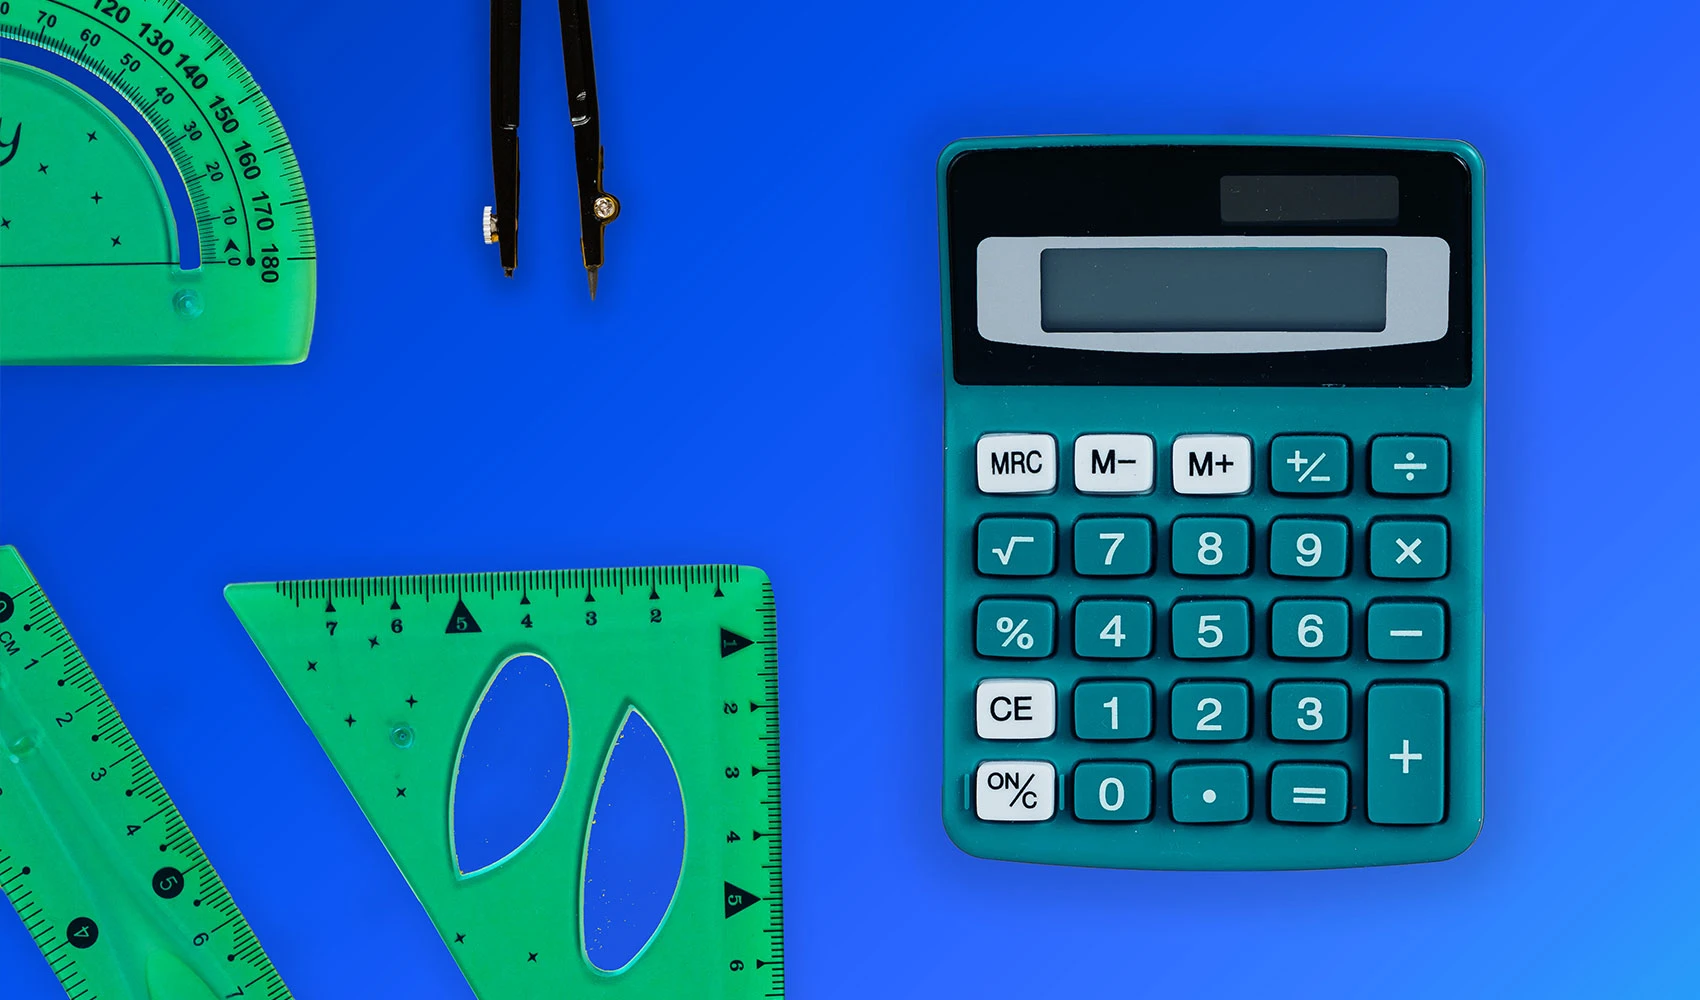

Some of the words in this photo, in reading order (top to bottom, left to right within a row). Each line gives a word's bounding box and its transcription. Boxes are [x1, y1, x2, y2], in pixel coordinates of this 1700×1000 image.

[0, 1, 10, 16] 0
[37, 10, 57, 28] 70
[79, 27, 102, 48] 60
[138, 21, 176, 58] 130
[119, 52, 142, 74] 50
[173, 52, 210, 91] 140
[153, 85, 176, 106] 40
[207, 94, 241, 135] 150
[183, 120, 204, 142] 30
[233, 139, 263, 181] 160
[205, 161, 224, 182] 20
[222, 205, 238, 226] 10
[251, 190, 275, 231] 170
[227, 257, 242, 267] 0
[260, 243, 280, 284] 180
[991, 449, 1043, 476] MRC
[1188, 451, 1234, 477] M+
[1099, 532, 1125, 565] 7
[1197, 531, 1223, 566] 8
[1296, 533, 1322, 567] 9
[390, 618, 404, 634] 6
[456, 616, 468, 631] 5
[520, 613, 533, 629] 4
[585, 610, 598, 626] 3
[650, 608, 662, 624] 2
[325, 621, 338, 636] 7
[996, 616, 1034, 650] %
[1099, 614, 1126, 647] 4
[1197, 614, 1224, 648] 5
[1297, 613, 1324, 648] 6
[0, 630, 21, 657] CM
[723, 639, 737, 649] 1
[24, 658, 39, 670] 1
[723, 702, 739, 715] 2
[989, 695, 1033, 722] CE
[1103, 696, 1119, 730] 1
[1196, 697, 1222, 731] 2
[1297, 696, 1323, 731] 3
[55, 711, 74, 728] 2
[90, 767, 107, 782] 3
[724, 766, 740, 779] 3
[1098, 777, 1125, 811] 0
[126, 824, 142, 836] 4
[726, 830, 741, 844] 4
[159, 875, 178, 891] 5
[727, 894, 742, 906] 5
[73, 925, 90, 938] 4
[192, 932, 210, 947] 6
[729, 959, 745, 972] 6
[225, 985, 245, 999] 7
